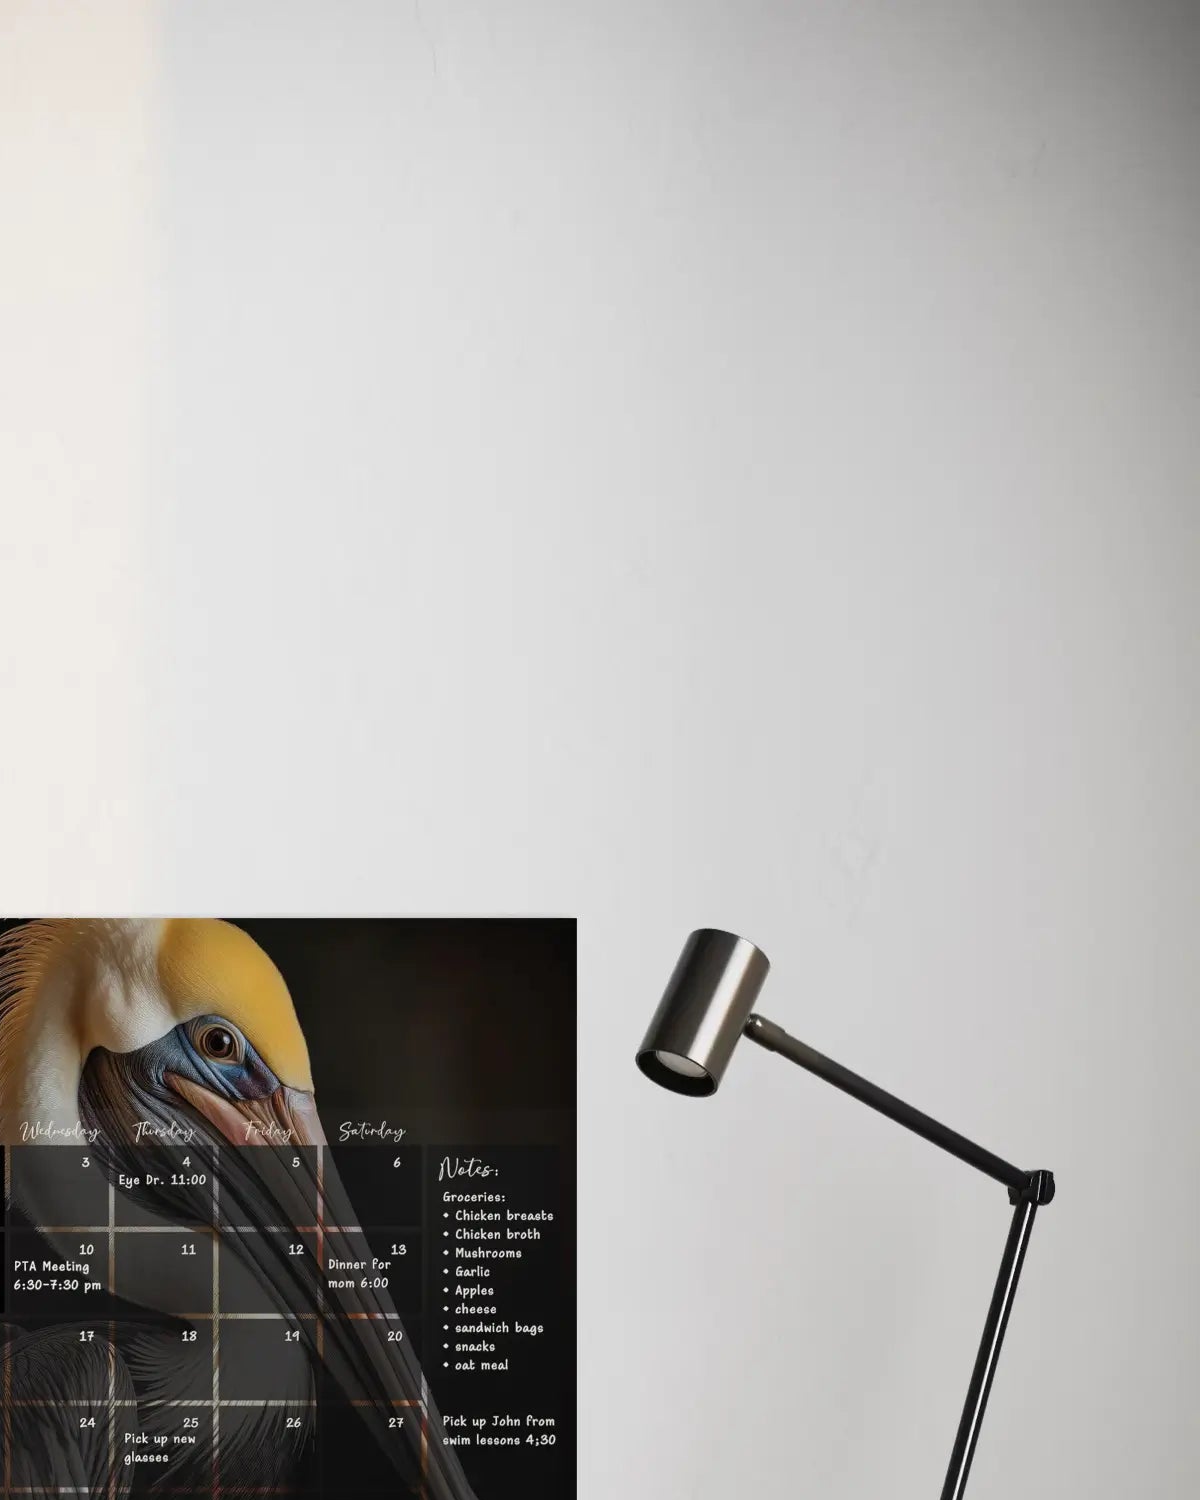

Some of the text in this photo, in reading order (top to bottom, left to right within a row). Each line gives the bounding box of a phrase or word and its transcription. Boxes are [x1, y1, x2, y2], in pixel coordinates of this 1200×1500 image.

[19, 1121, 100, 1142] Wednesday
[132, 1121, 196, 1142] Thursday
[242, 1121, 295, 1142] Friday
[338, 1121, 406, 1142] Saturday
[81, 1157, 90, 1168] 3
[182, 1157, 191, 1168] 4
[291, 1157, 300, 1168] 5
[393, 1157, 401, 1168] 6
[438, 1156, 499, 1182] Notes:
[118, 1174, 207, 1187] Eye Dr. 11:00
[442, 1192, 506, 1203] Groceries:
[455, 1210, 554, 1221] Chicken breasts
[455, 1228, 541, 1240] Chicken broth
[79, 1244, 94, 1255] 10
[181, 1244, 196, 1255] 11
[288, 1244, 304, 1255] 12
[391, 1244, 407, 1255] 13
[455, 1247, 522, 1259] Mushrooms
[14, 1261, 89, 1274] PTA Meeting
[328, 1259, 391, 1270] Dinner for
[455, 1266, 490, 1278] Garlic
[14, 1279, 102, 1293] 6:30-7:30 pm
[328, 1277, 389, 1289] mom 6:00
[455, 1285, 494, 1298] Apples
[455, 1303, 497, 1315] cheese
[455, 1322, 544, 1335] sandwich bags
[79, 1331, 94, 1342] 17
[181, 1331, 197, 1342] 18
[284, 1331, 300, 1342] 19
[387, 1331, 403, 1342] 20
[455, 1341, 496, 1352] snacks
[455, 1359, 509, 1371] oat meal
[79, 1417, 96, 1428] 24
[183, 1417, 199, 1428] 25
[286, 1417, 301, 1428] 26
[388, 1417, 404, 1428] 27
[442, 1415, 555, 1430] Pick up John from
[124, 1433, 196, 1447] Pick up new
[442, 1434, 556, 1447] swim lessons 4;30
[124, 1452, 169, 1465] glasses
